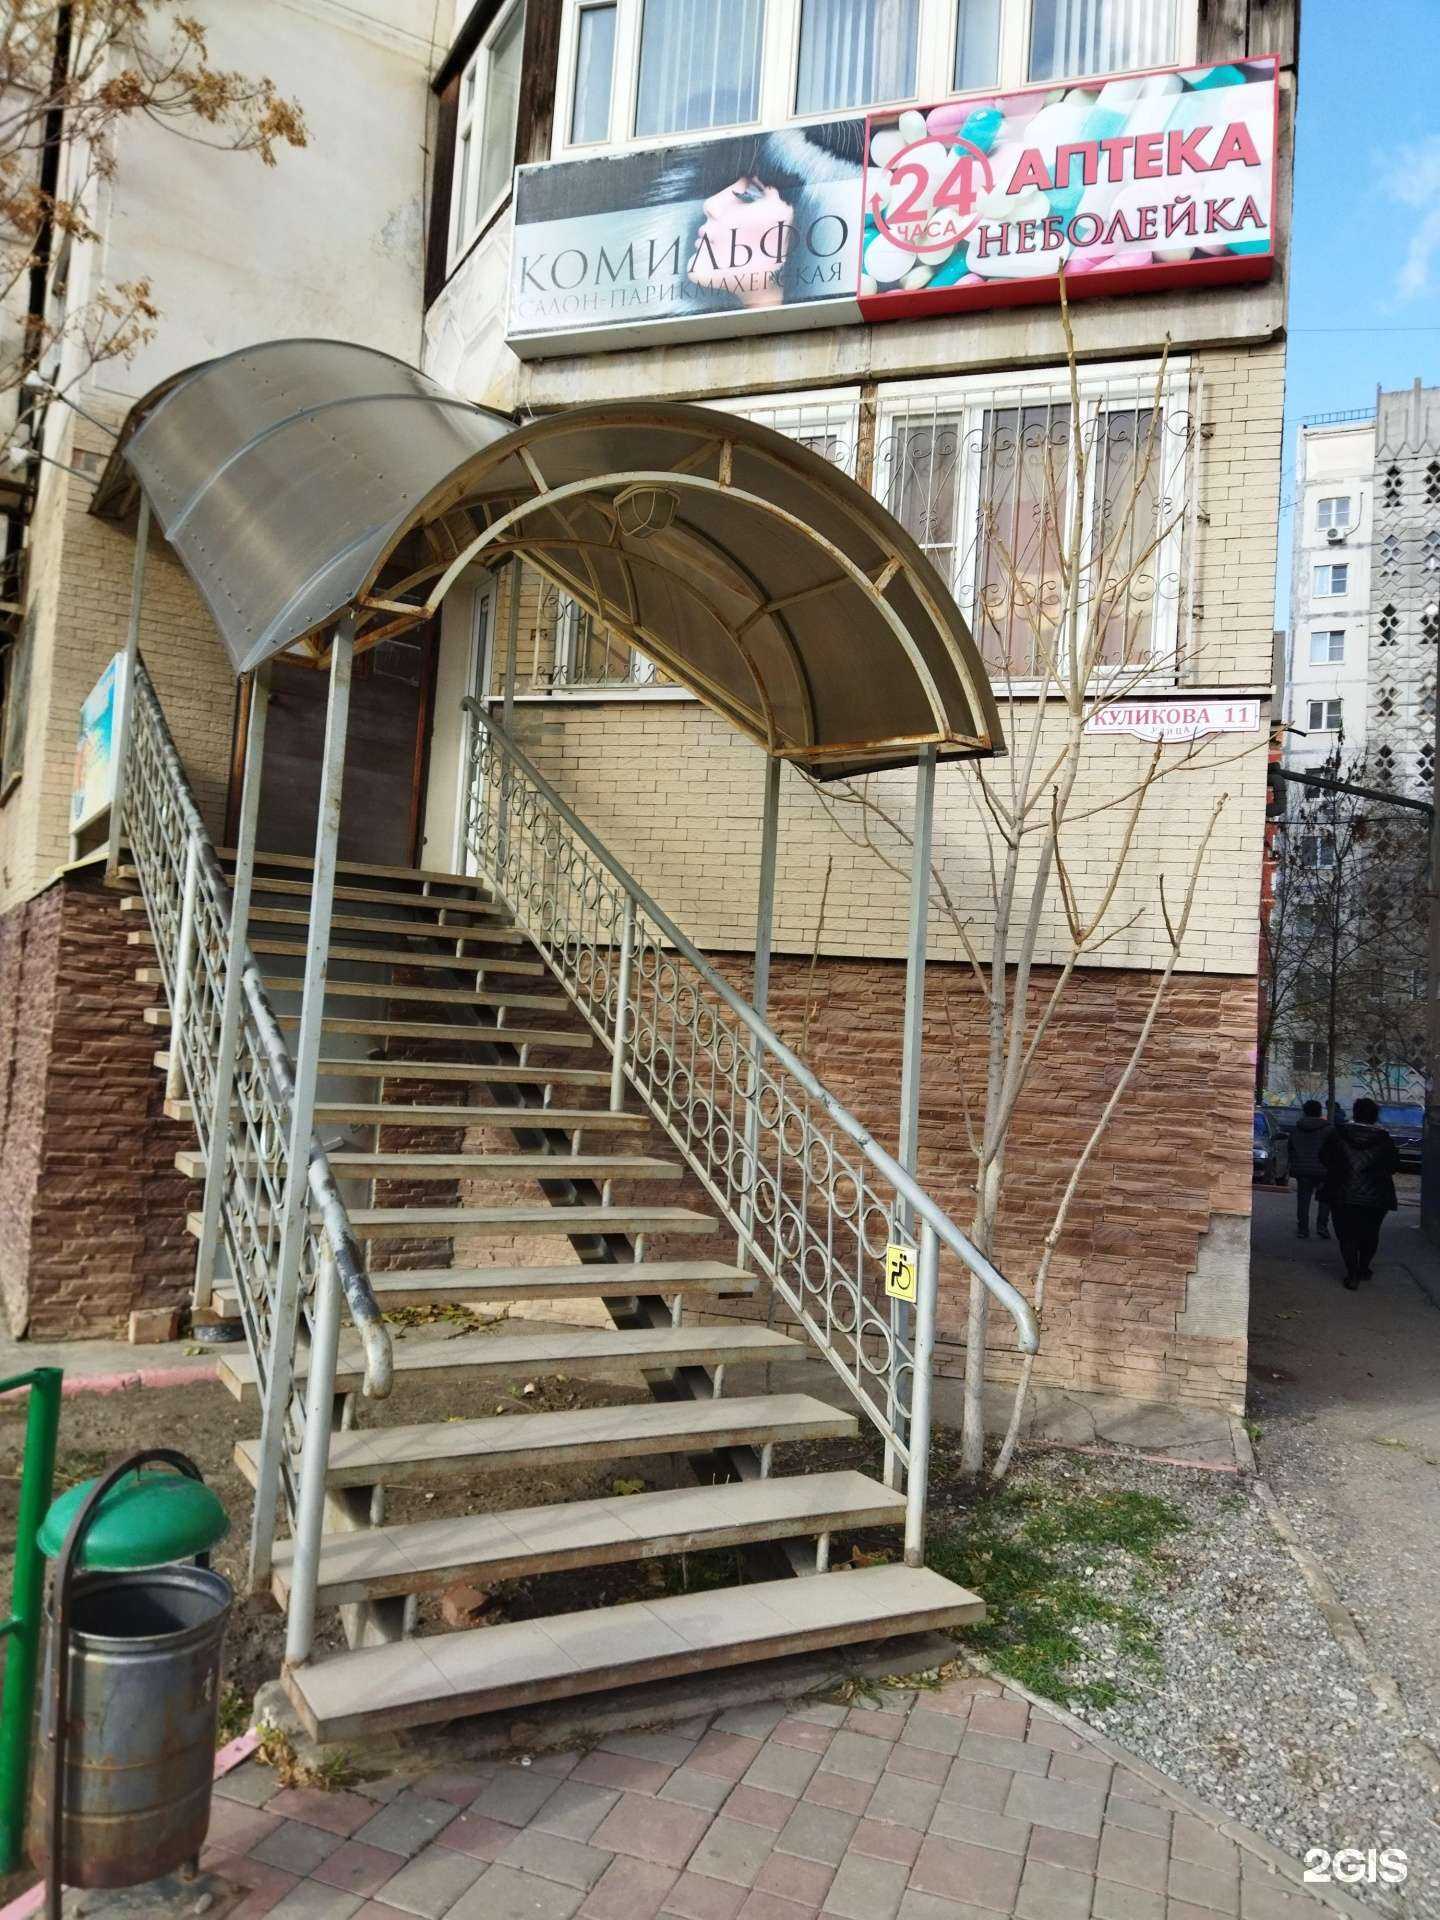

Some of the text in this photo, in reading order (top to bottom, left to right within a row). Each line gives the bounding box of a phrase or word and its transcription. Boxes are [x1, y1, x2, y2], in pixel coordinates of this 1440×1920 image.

[886, 156, 977, 226] 24
[1006, 121, 1262, 195] АПТЕКА
[520, 214, 849, 294] КОМИЛЬФО
[896, 220, 958, 243] ЧАСА
[976, 194, 1268, 259] НЕБОЛЕЙКА
[1094, 706, 1249, 726] КУЛИКОВА 11
